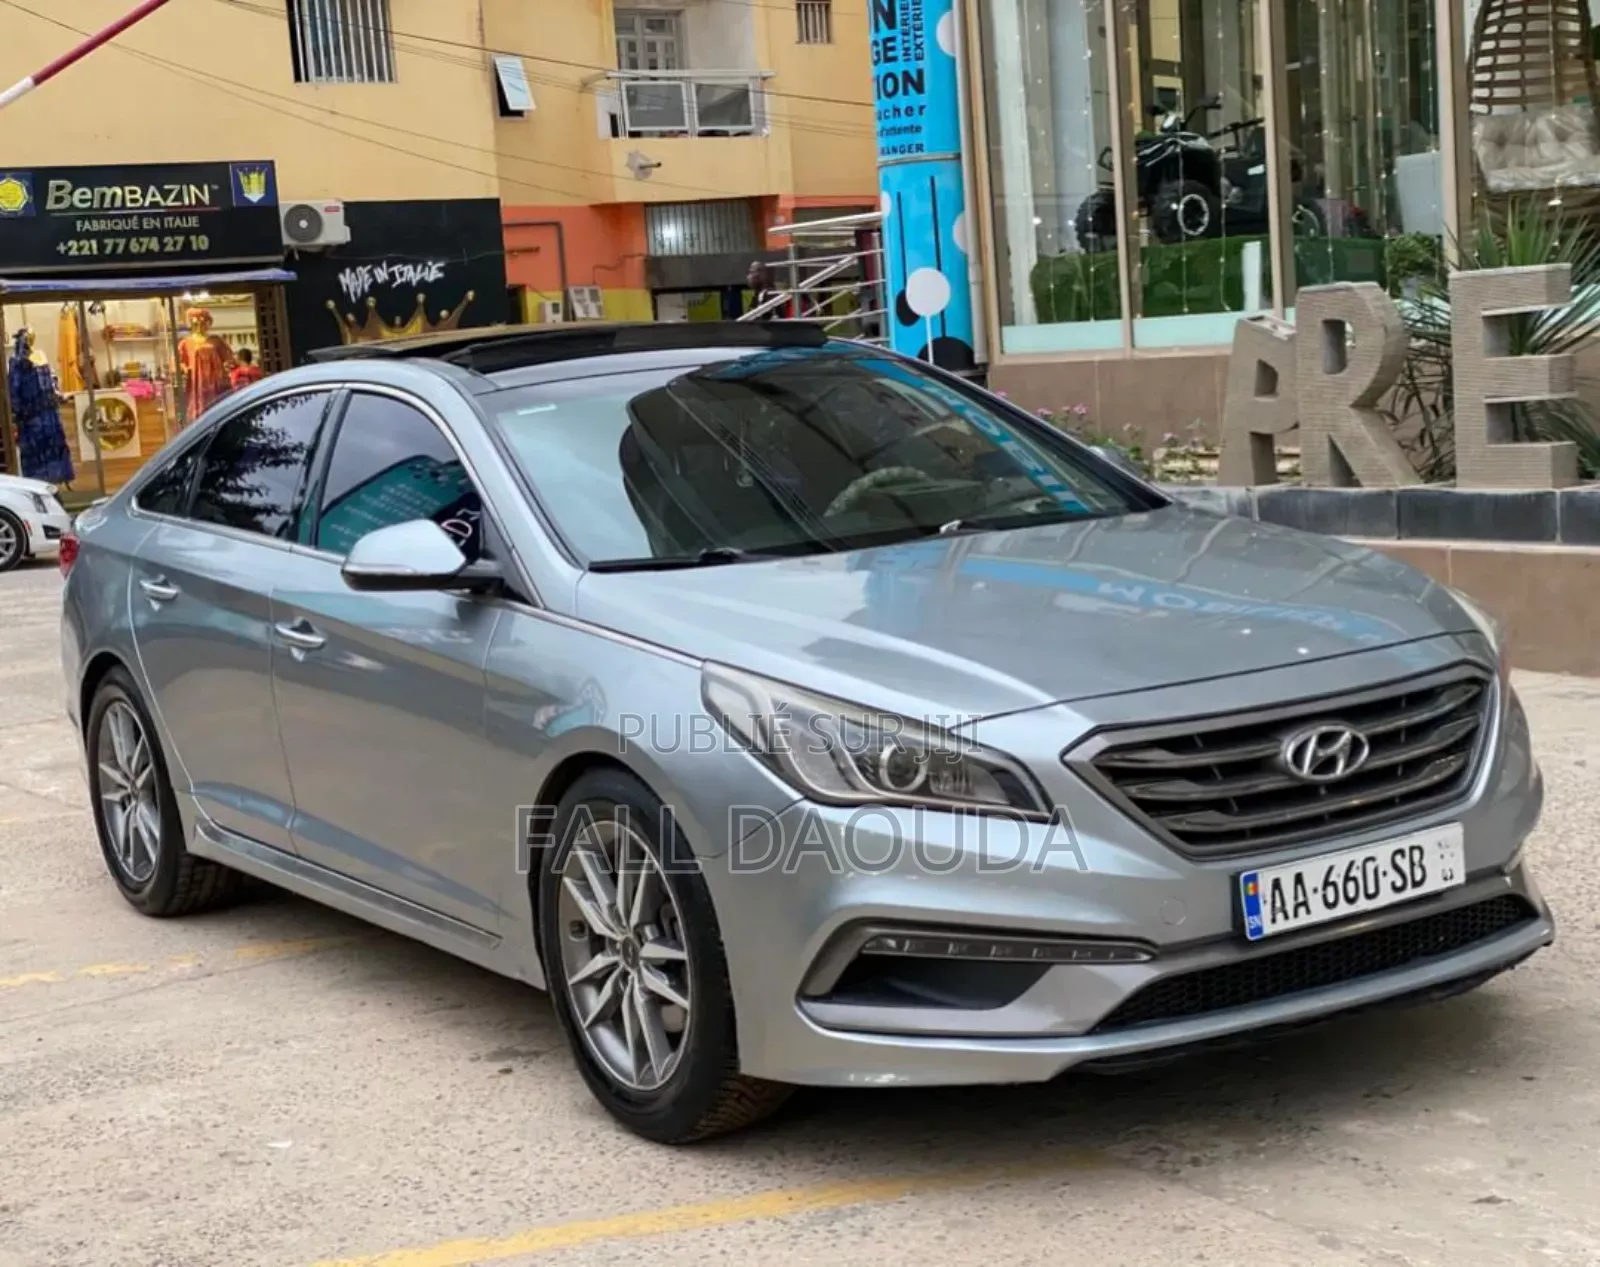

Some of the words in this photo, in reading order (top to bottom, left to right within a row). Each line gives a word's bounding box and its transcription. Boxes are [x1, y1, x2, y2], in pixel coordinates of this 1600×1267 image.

[76, 215, 140, 232] FABRIQUÉ
[142, 218, 161, 230] EN
[164, 216, 201, 229] ITALIE
[56, 239, 99, 256] +221
[104, 237, 127, 254] 77
[129, 236, 160, 253] 674
[163, 236, 186, 252] 27
[189, 234, 210, 251] 10
